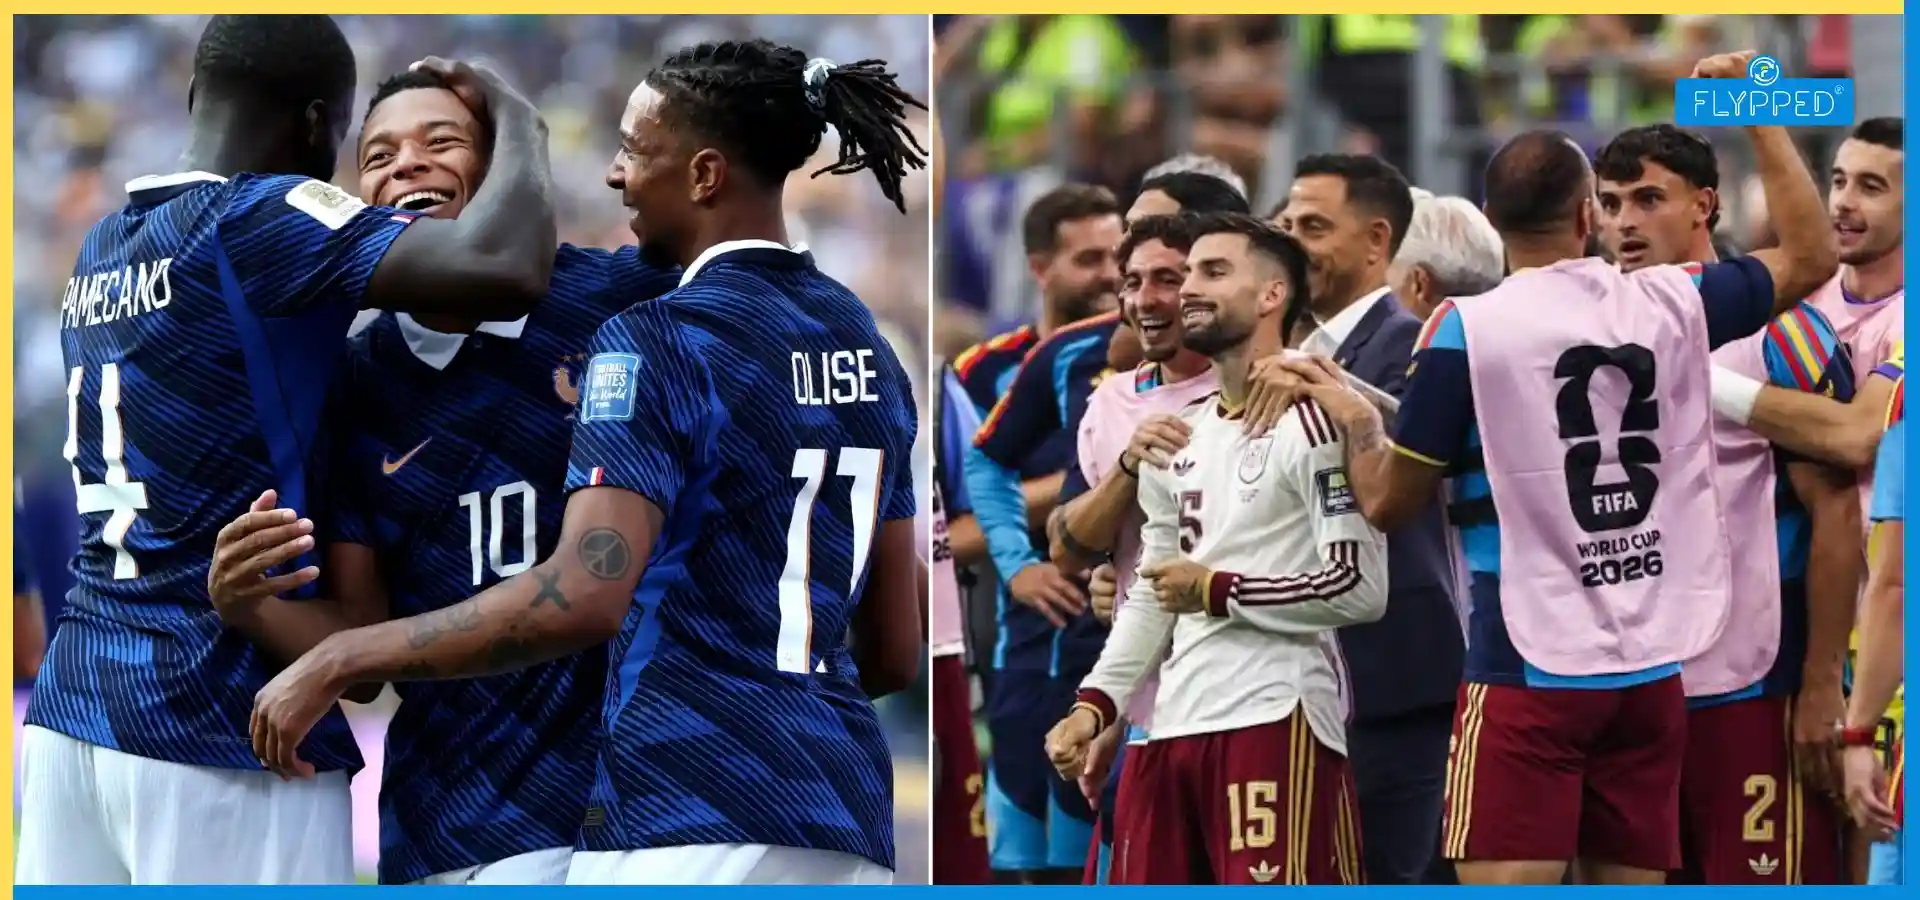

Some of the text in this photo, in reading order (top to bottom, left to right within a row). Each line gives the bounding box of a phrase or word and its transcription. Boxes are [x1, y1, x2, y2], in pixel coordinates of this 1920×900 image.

[792, 348, 880, 406] OLISE
[63, 363, 149, 580] 4
[1592, 491, 1638, 515] FIFA
[458, 480, 538, 585] 10
[1173, 490, 1203, 555] 5
[1577, 530, 1662, 558] WORLD CUP
[777, 446, 885, 674] 11
[1580, 550, 1664, 587] 2026
[1227, 781, 1278, 852] 15
[1742, 774, 1777, 842] 2
